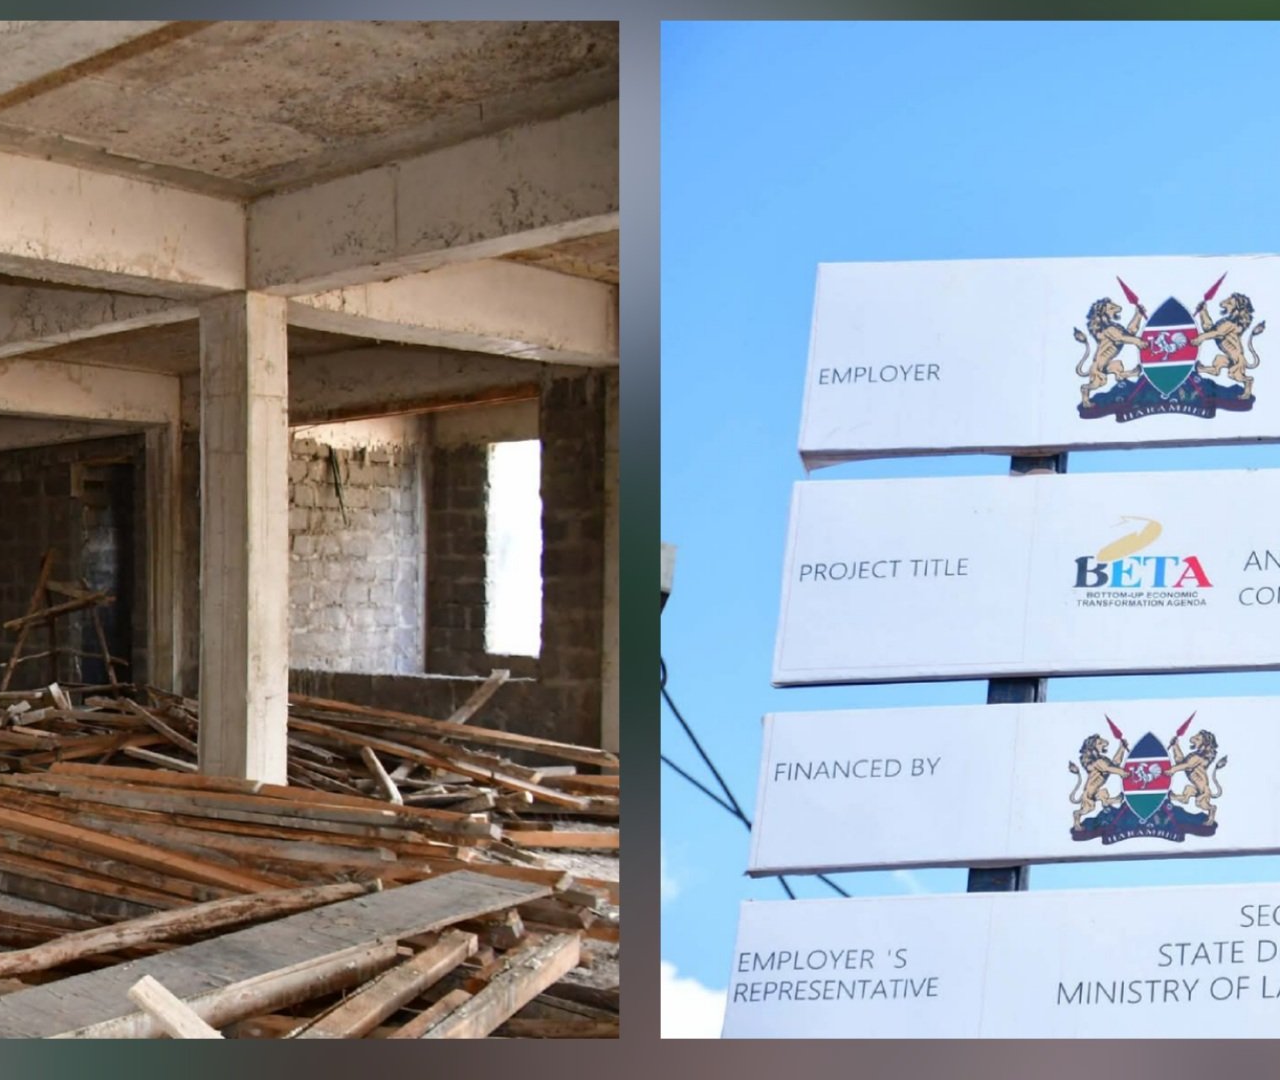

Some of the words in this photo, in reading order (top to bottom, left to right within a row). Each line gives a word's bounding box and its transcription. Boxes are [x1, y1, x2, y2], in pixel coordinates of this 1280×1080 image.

[819, 364, 940, 385] EMPLOYER
[799, 560, 902, 582] PROJECT
[910, 558, 968, 577] TITLE
[1072, 555, 1214, 588] BETA
[1077, 599, 1164, 607] TRANSFORMATION
[1167, 599, 1207, 607] AGENDA
[1086, 591, 1144, 599] BOTTOM-UP
[1147, 591, 1199, 599] ECONOMIC
[774, 759, 902, 782] FINANCED
[911, 757, 941, 777] BY
[738, 949, 874, 972] EMPLOYER
[1158, 940, 1244, 967] STATE
[733, 977, 939, 1003] REPRESENTATIVE
[1057, 978, 1199, 1005] MINISTRY
[1210, 976, 1250, 1001] OF
